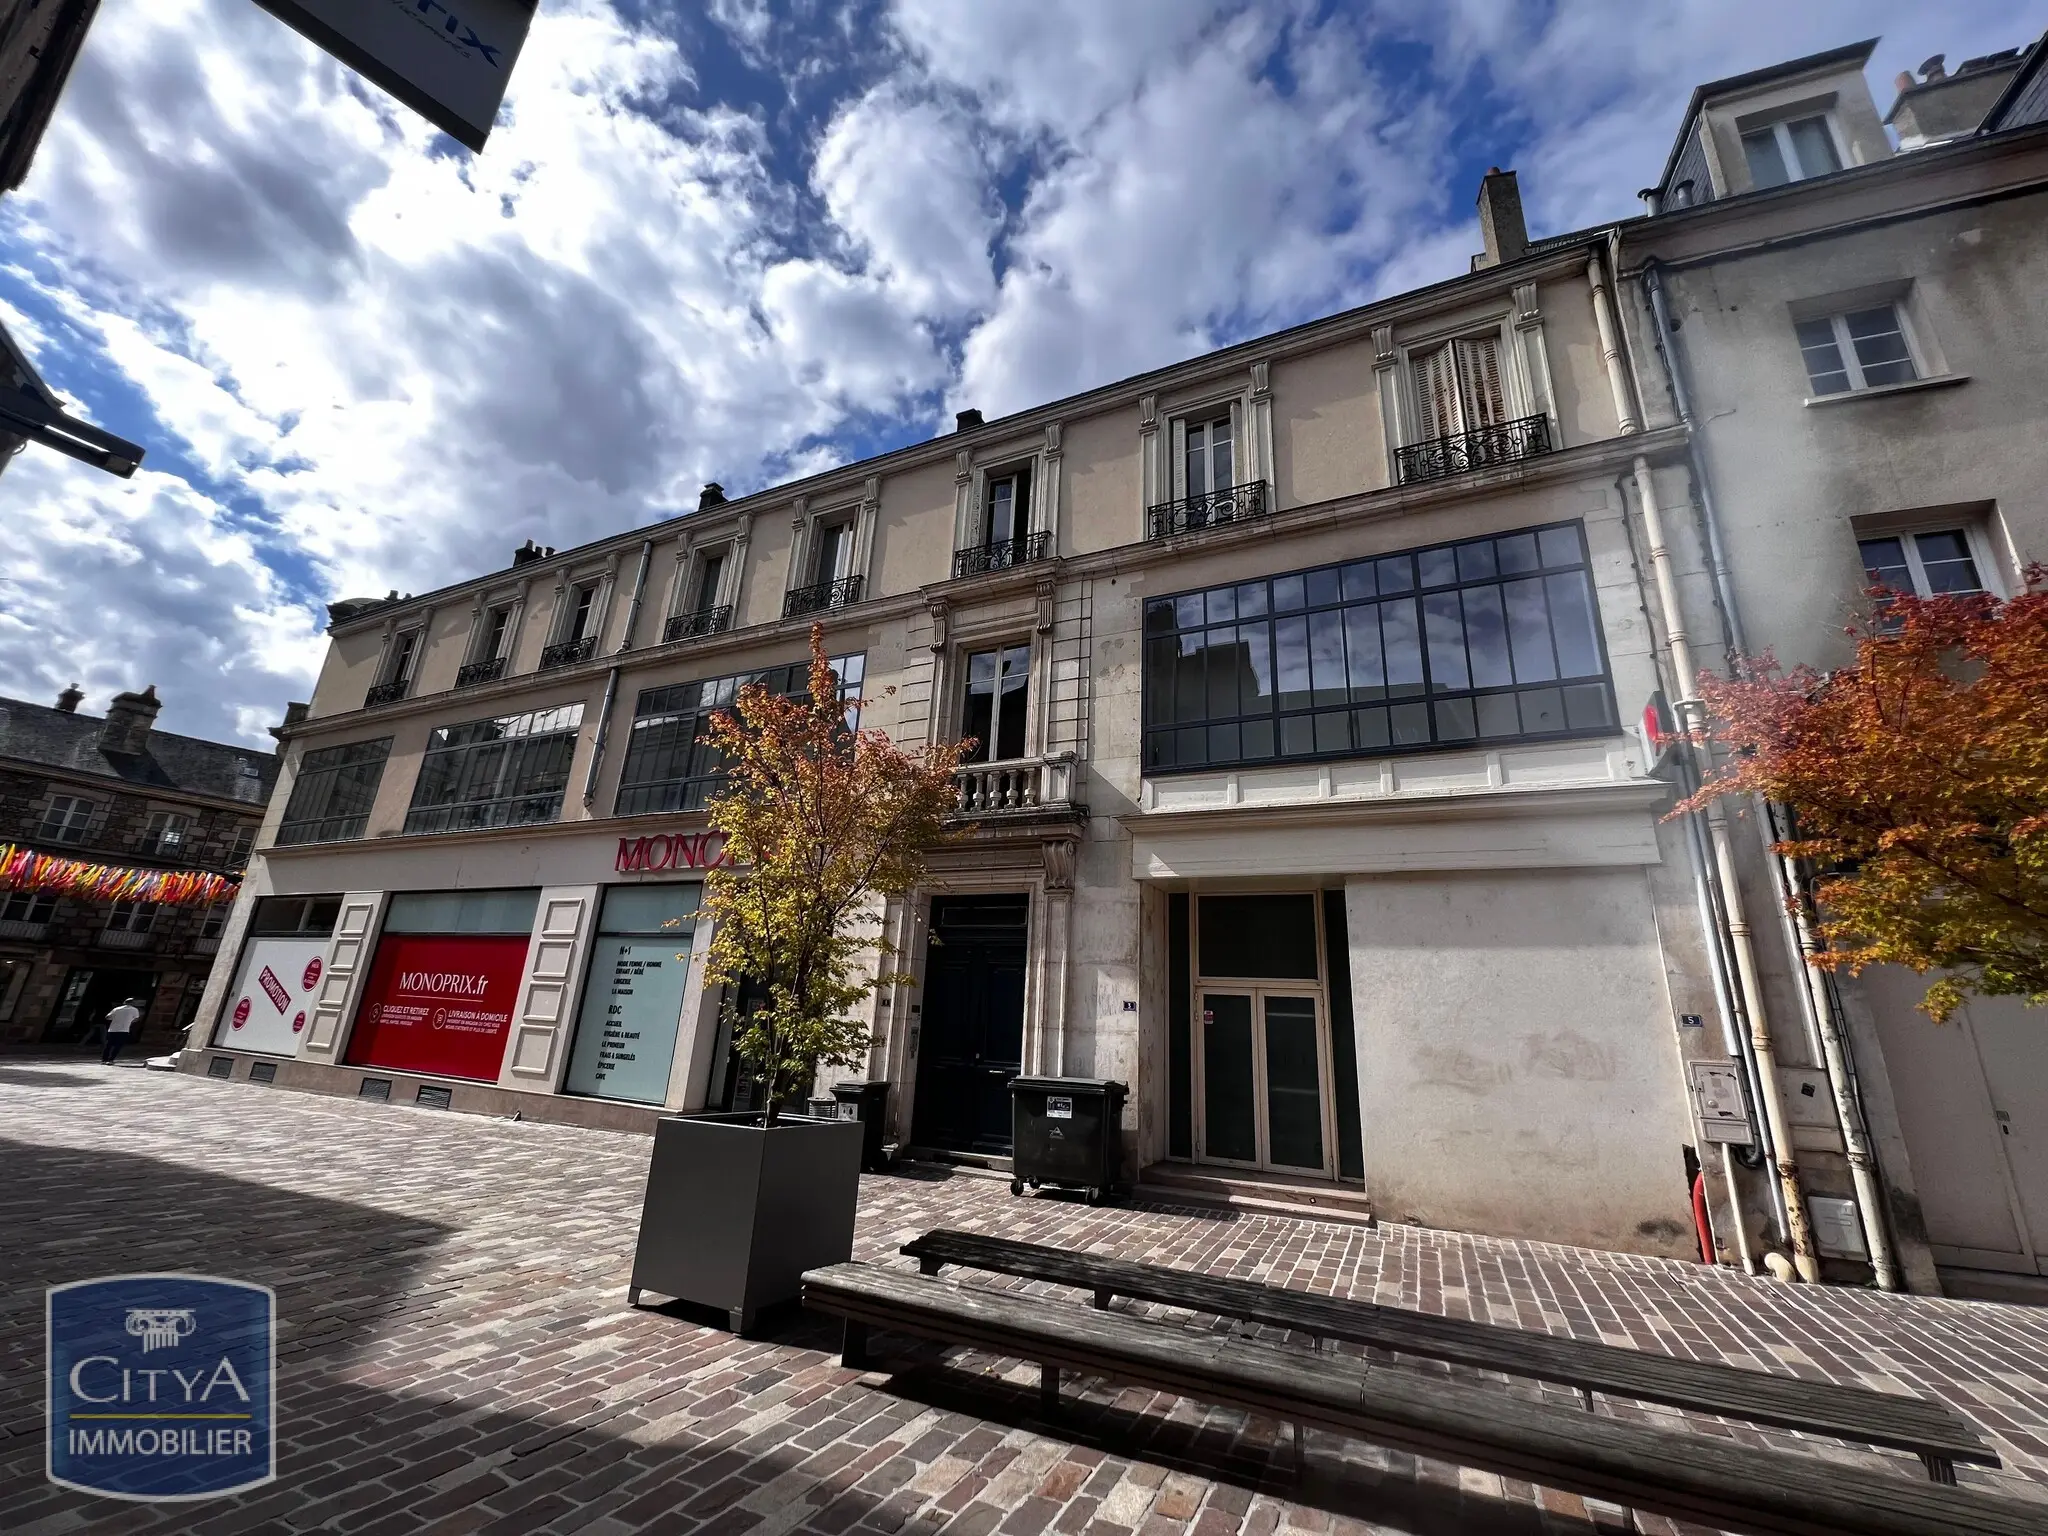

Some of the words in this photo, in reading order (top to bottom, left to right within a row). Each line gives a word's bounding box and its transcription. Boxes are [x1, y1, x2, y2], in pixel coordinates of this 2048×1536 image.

[619, 946, 631, 955] N+1
[399, 972, 489, 995] MONOPRIX.fr
[260, 969, 289, 1012] PROMOTION
[383, 1004, 403, 1014] CLIQUEZ
[410, 1007, 430, 1016] RETIREZ
[608, 1005, 622, 1014] RDC
[448, 1010, 476, 1019] LIVRAISON
[480, 1012, 508, 1023] DOMICILE
[624, 1031, 640, 1039] BEAUTÉ
[615, 1052, 635, 1061] SURGELÉS
[597, 1061, 615, 1070] ÉPICERIE
